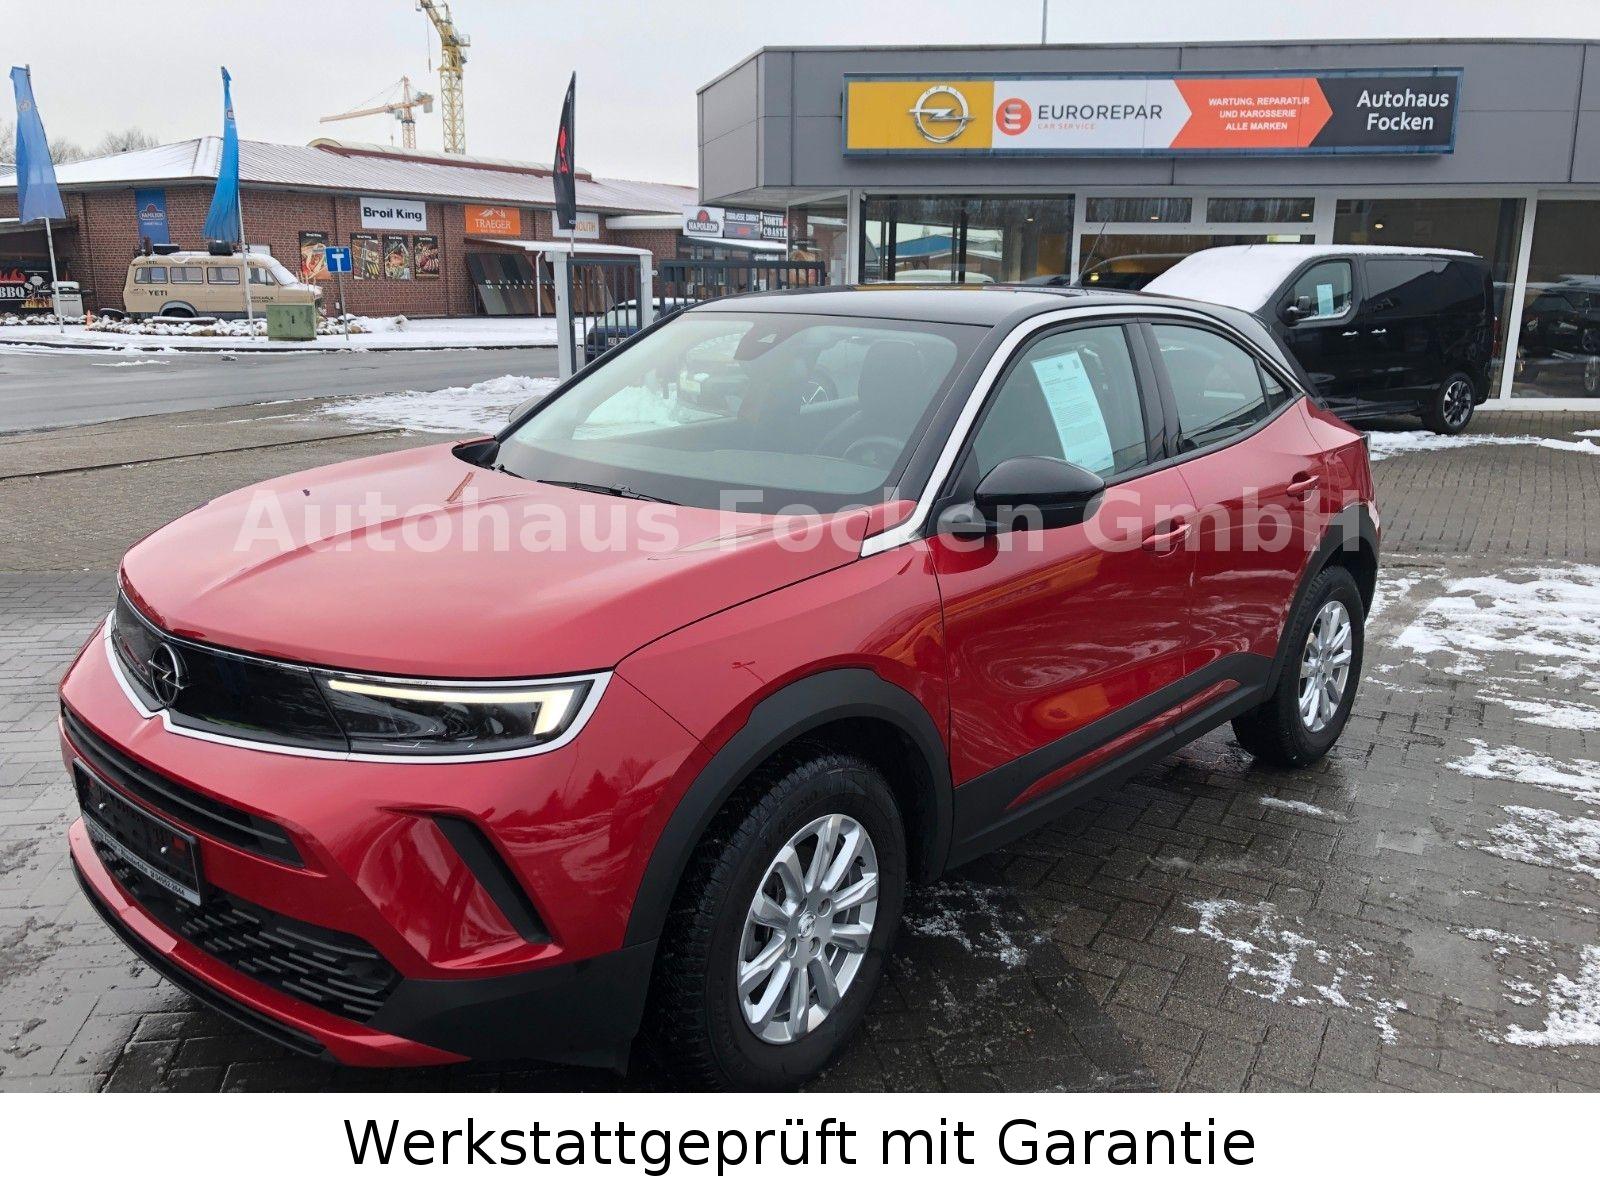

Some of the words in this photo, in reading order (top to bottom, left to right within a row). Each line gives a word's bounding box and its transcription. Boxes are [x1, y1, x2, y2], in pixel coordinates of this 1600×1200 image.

[1208, 97, 1255, 106] WARTUNG,
[1257, 96, 1310, 105] REPARATUR
[1357, 88, 1449, 108] Autohaus
[1038, 104, 1163, 120] EUROREPAR
[1219, 110, 1238, 118] UND
[1240, 109, 1297, 118] KAROSSERIE
[1037, 122, 1055, 130] CAR
[1057, 122, 1096, 130] SERVICE
[1225, 122, 1249, 131] ALLE
[1250, 121, 1288, 131] MARKEN
[1366, 111, 1434, 131] Focken
[363, 206, 394, 219] Broil
[396, 208, 423, 221] King
[475, 218, 511, 229] TRAEGER
[763, 215, 784, 227] NORTH
